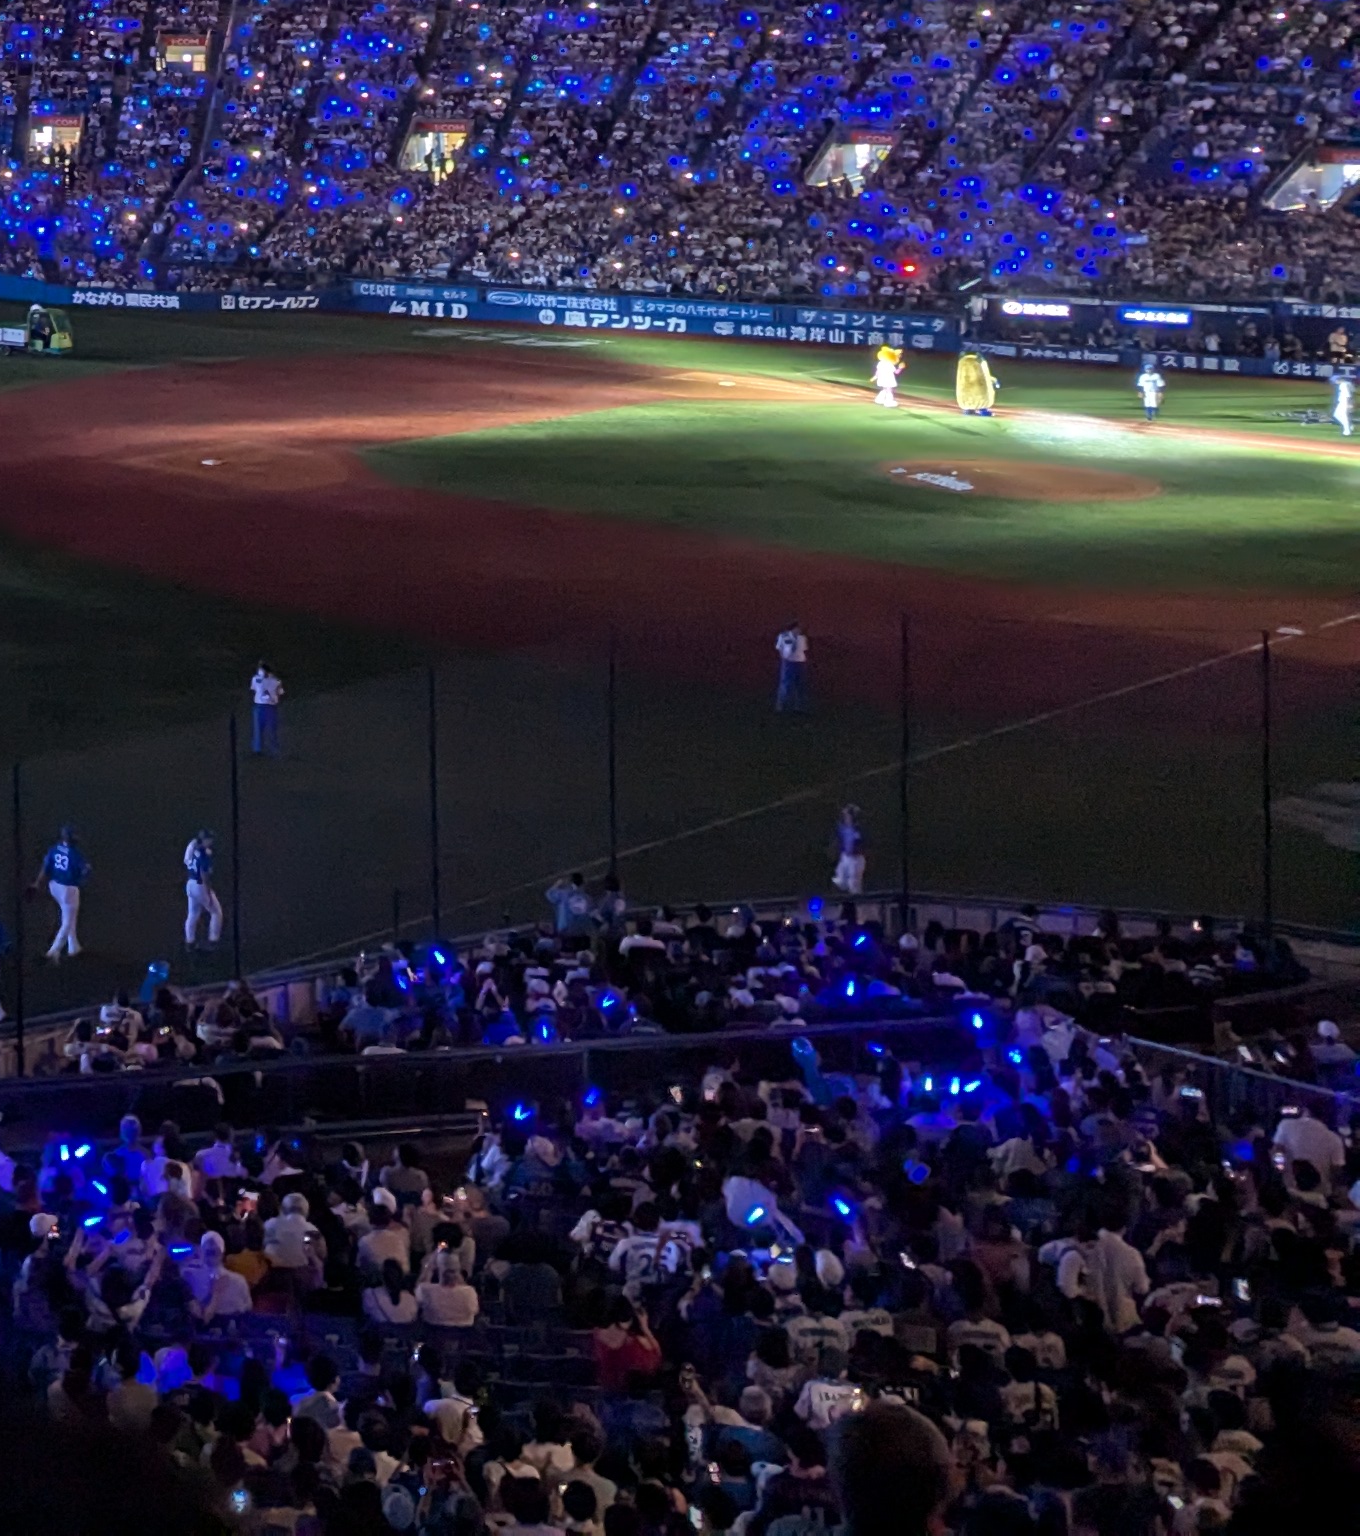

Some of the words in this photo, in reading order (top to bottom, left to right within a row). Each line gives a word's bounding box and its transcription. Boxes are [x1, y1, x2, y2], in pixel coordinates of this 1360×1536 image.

[71, 290, 180, 310] かながわ県民共済
[359, 283, 397, 297] CERTE
[410, 300, 469, 320] MID
[801, 309, 946, 333] ザ・コンピュータ
[790, 325, 906, 348] 湾岸山下商事
